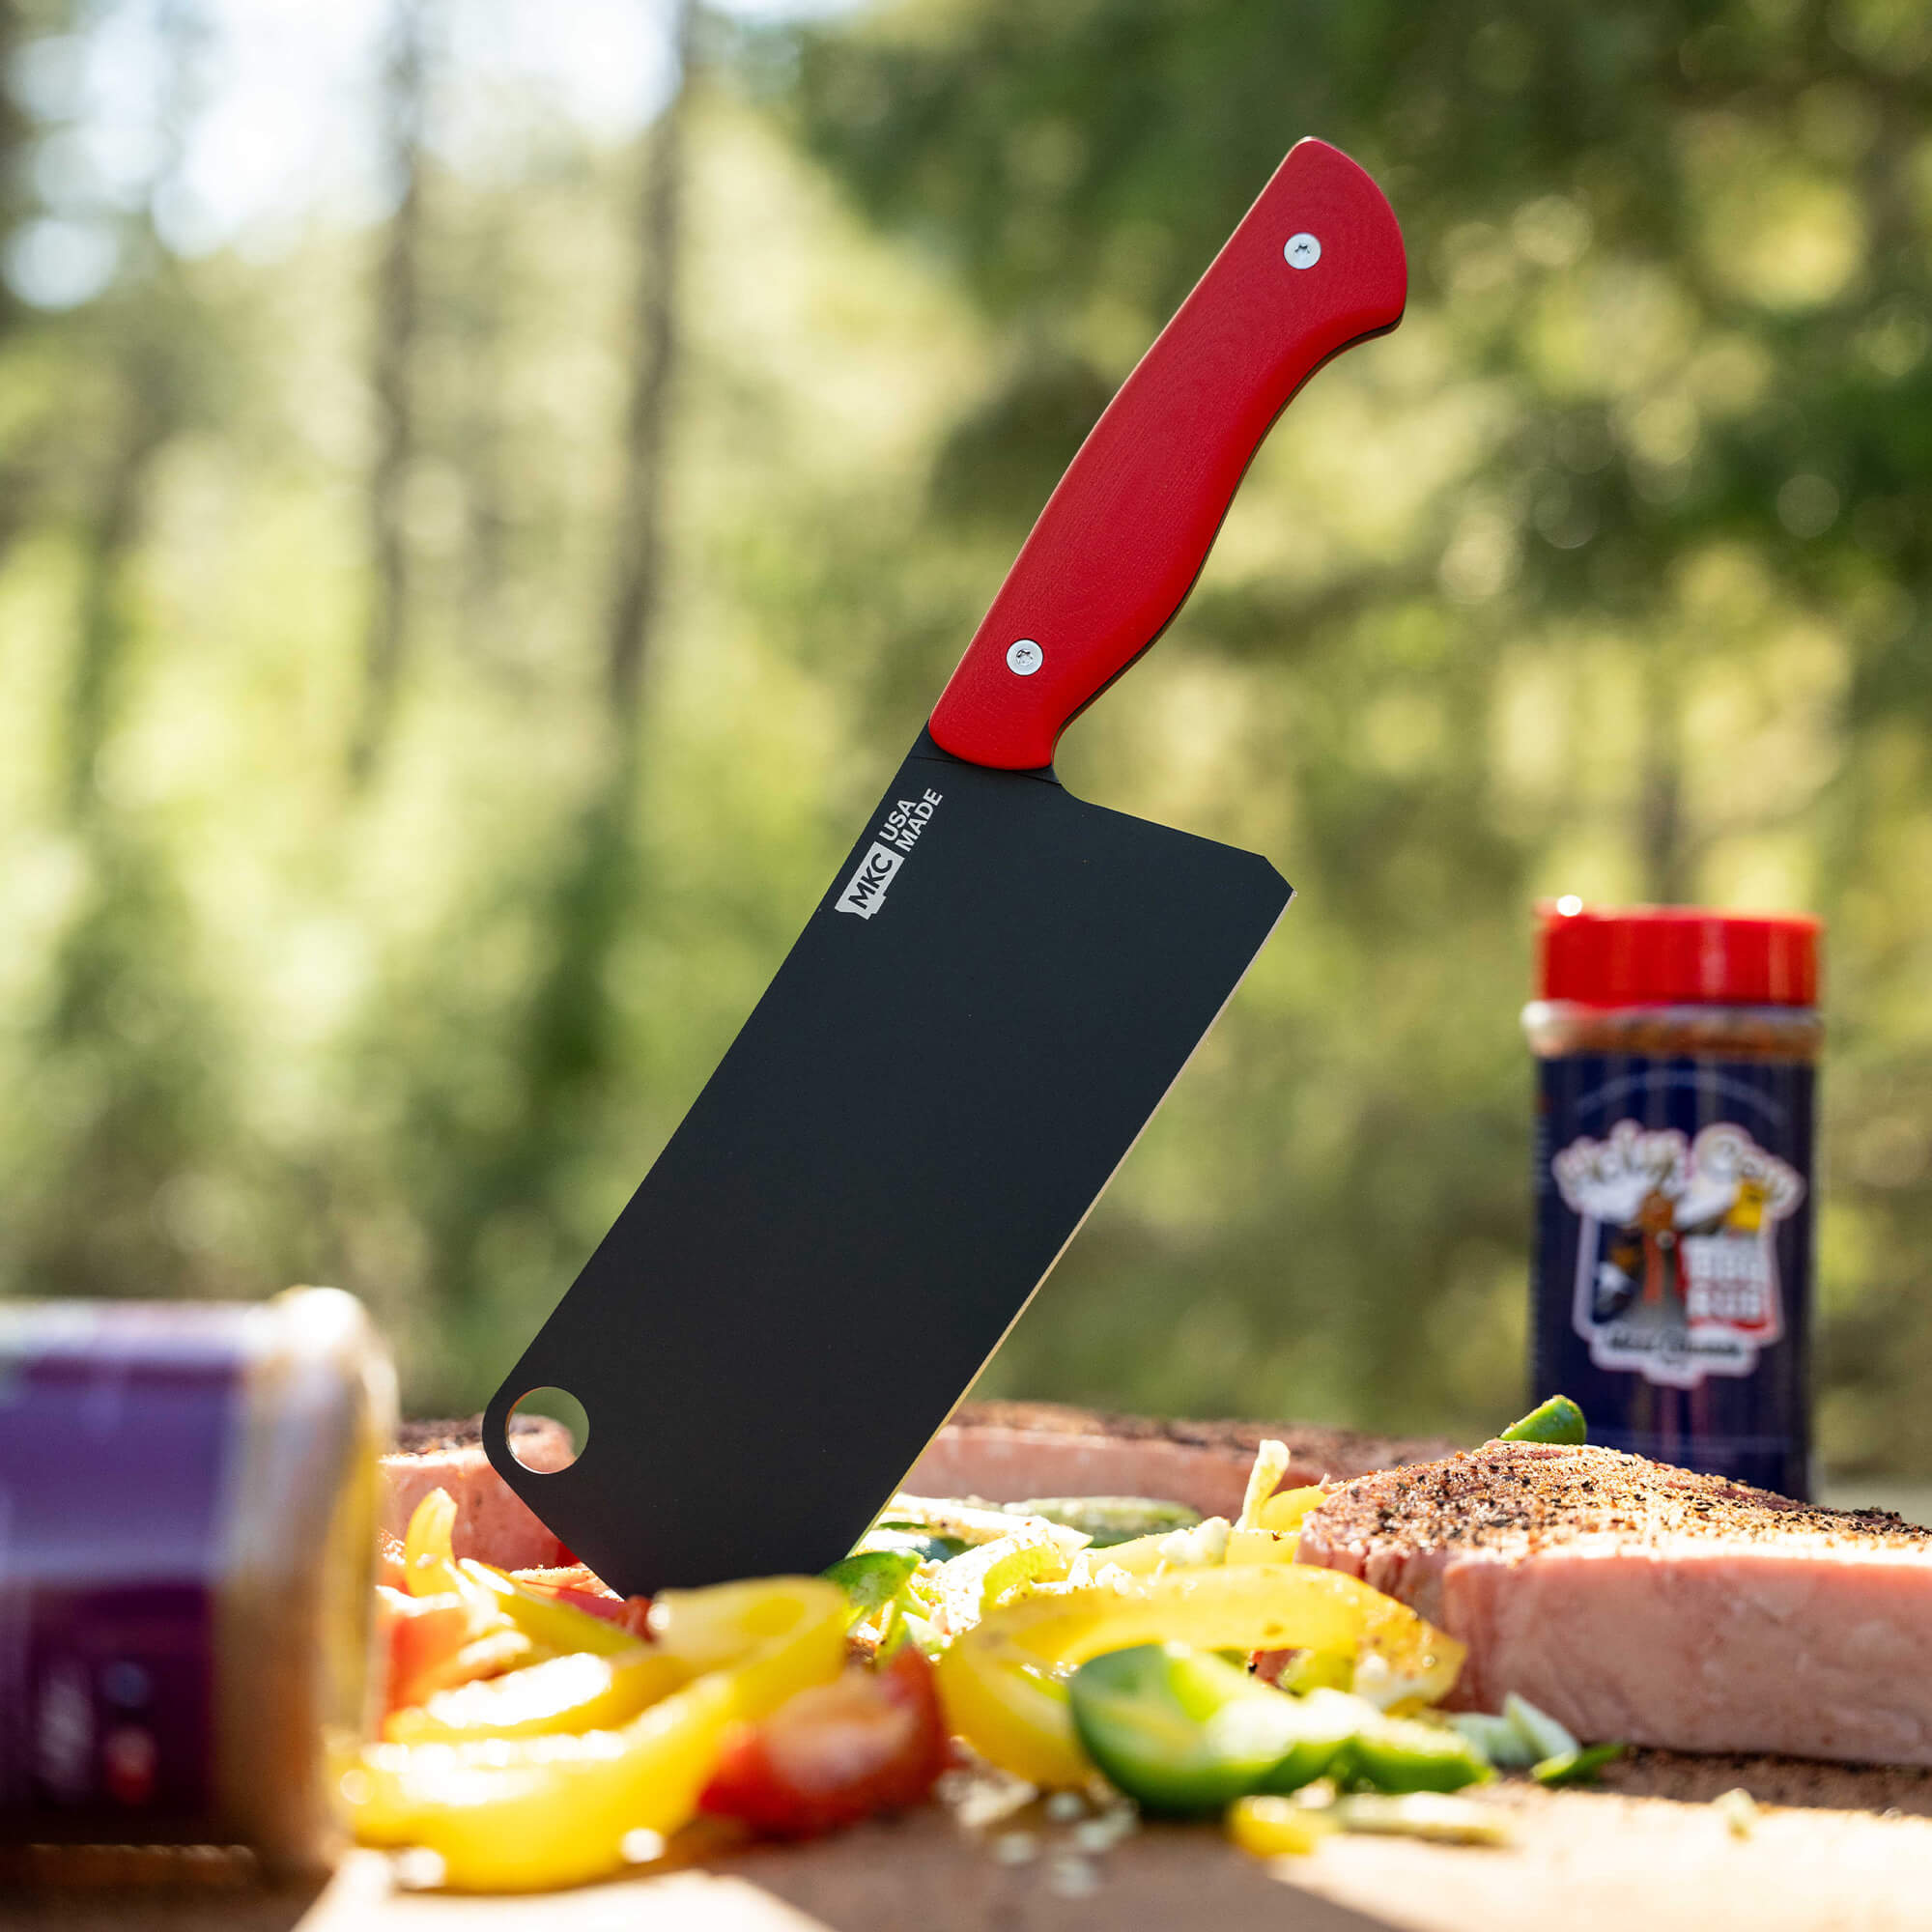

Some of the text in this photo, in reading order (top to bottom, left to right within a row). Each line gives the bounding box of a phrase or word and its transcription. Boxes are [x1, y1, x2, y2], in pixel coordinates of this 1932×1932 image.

[878, 800, 917, 841] USA
[895, 788, 943, 852] MADE
[848, 852, 893, 910] MKC
